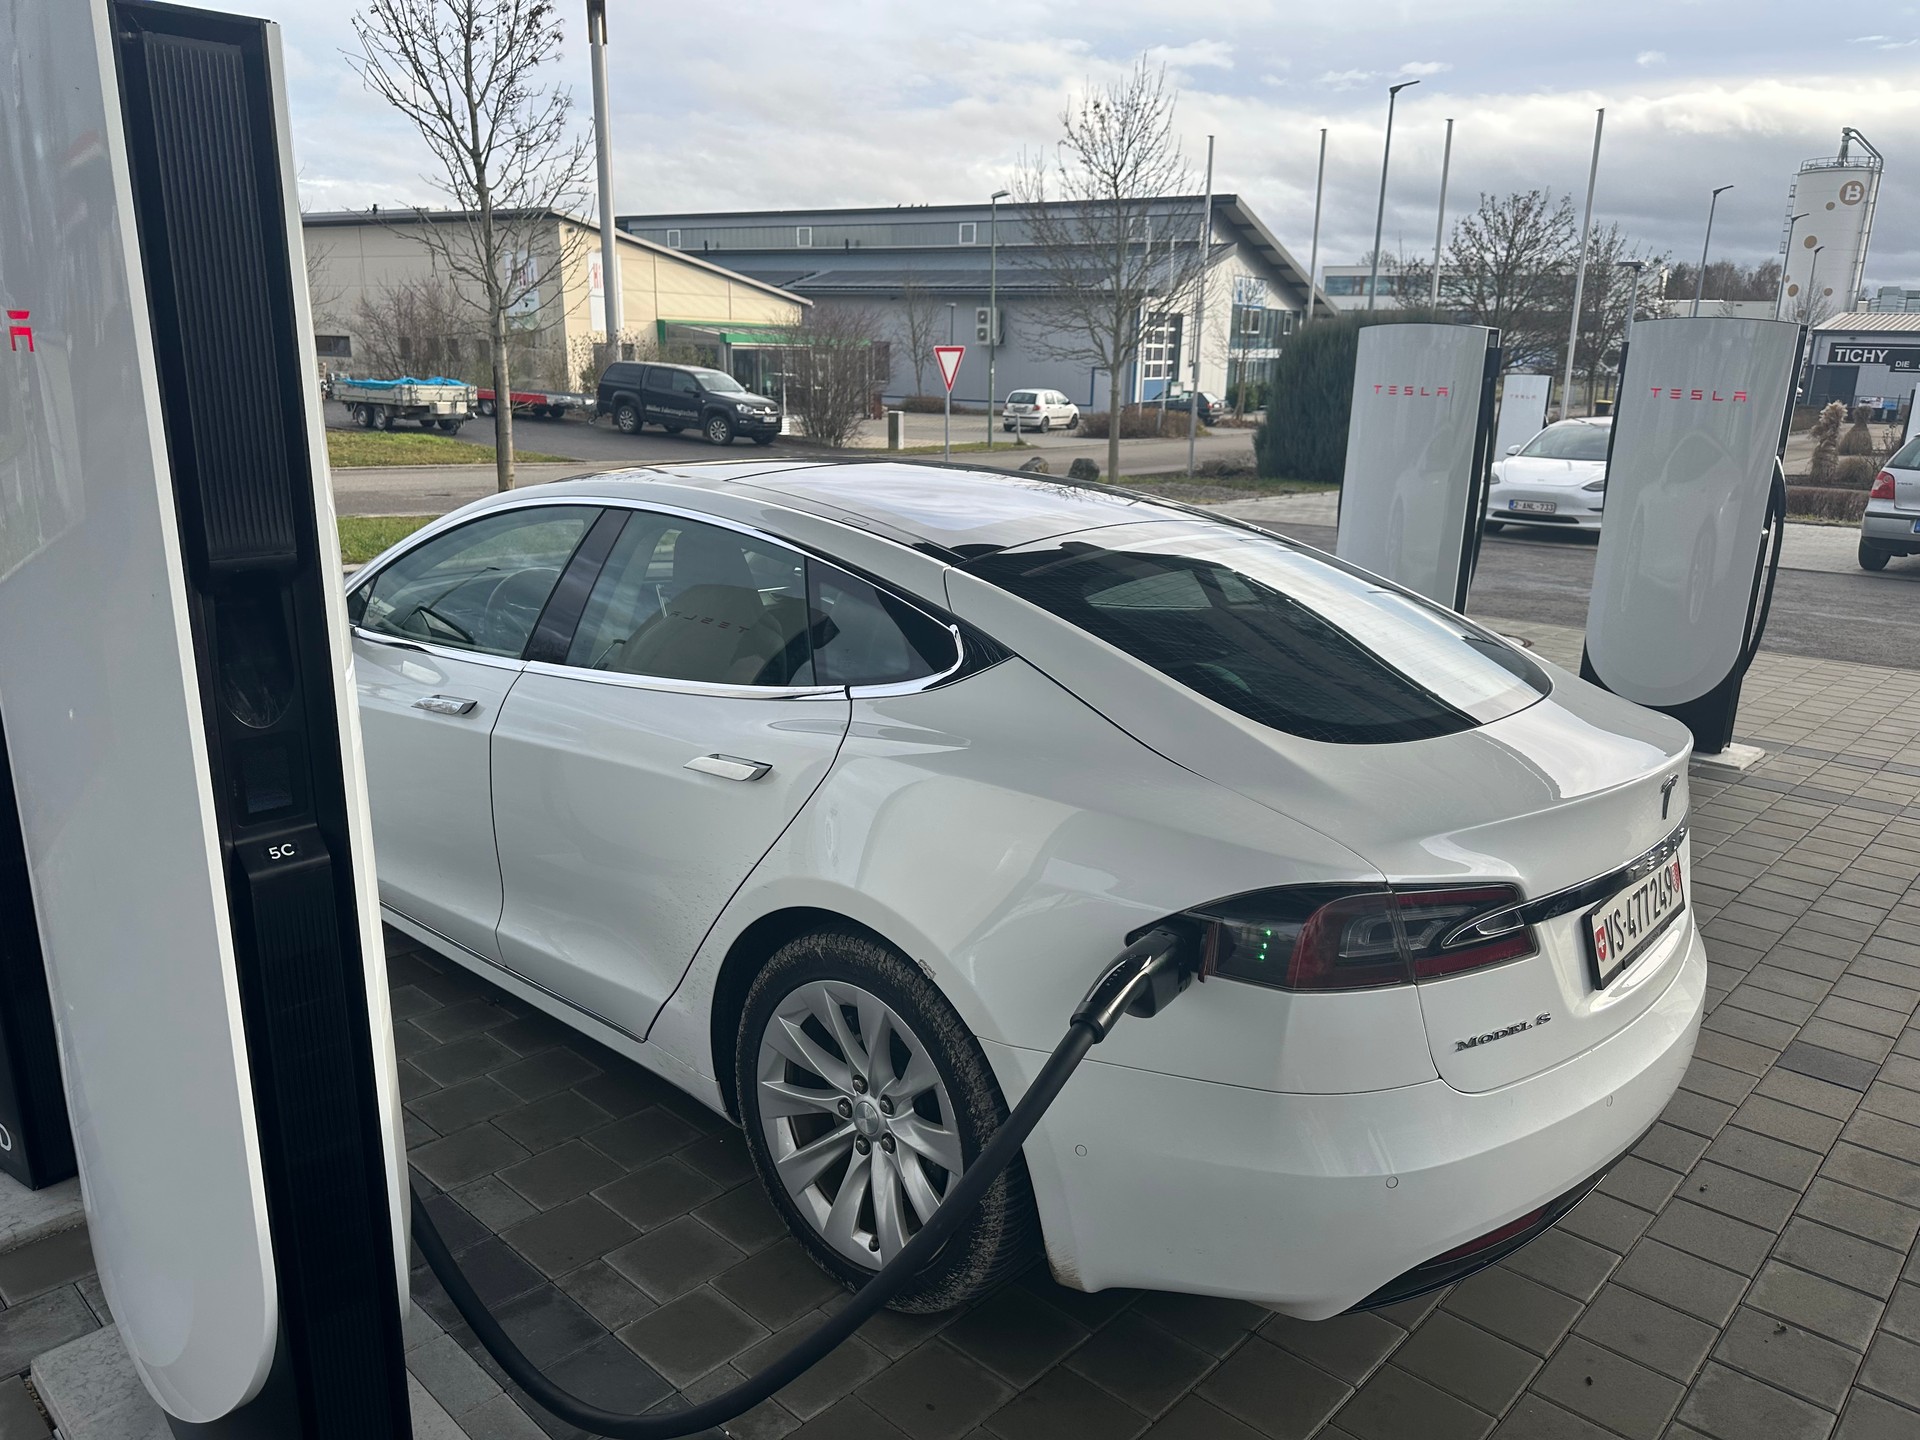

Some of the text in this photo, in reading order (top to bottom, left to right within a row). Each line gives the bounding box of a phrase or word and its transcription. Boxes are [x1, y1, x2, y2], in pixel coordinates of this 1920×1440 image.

[1835, 349, 1889, 363] TICHY
[1895, 360, 1911, 368] DIE
[1373, 385, 1449, 397] TESLA
[1650, 387, 1748, 402] TESLA
[269, 843, 295, 860] 5C
[1455, 1011, 1551, 1052] MODEL S
